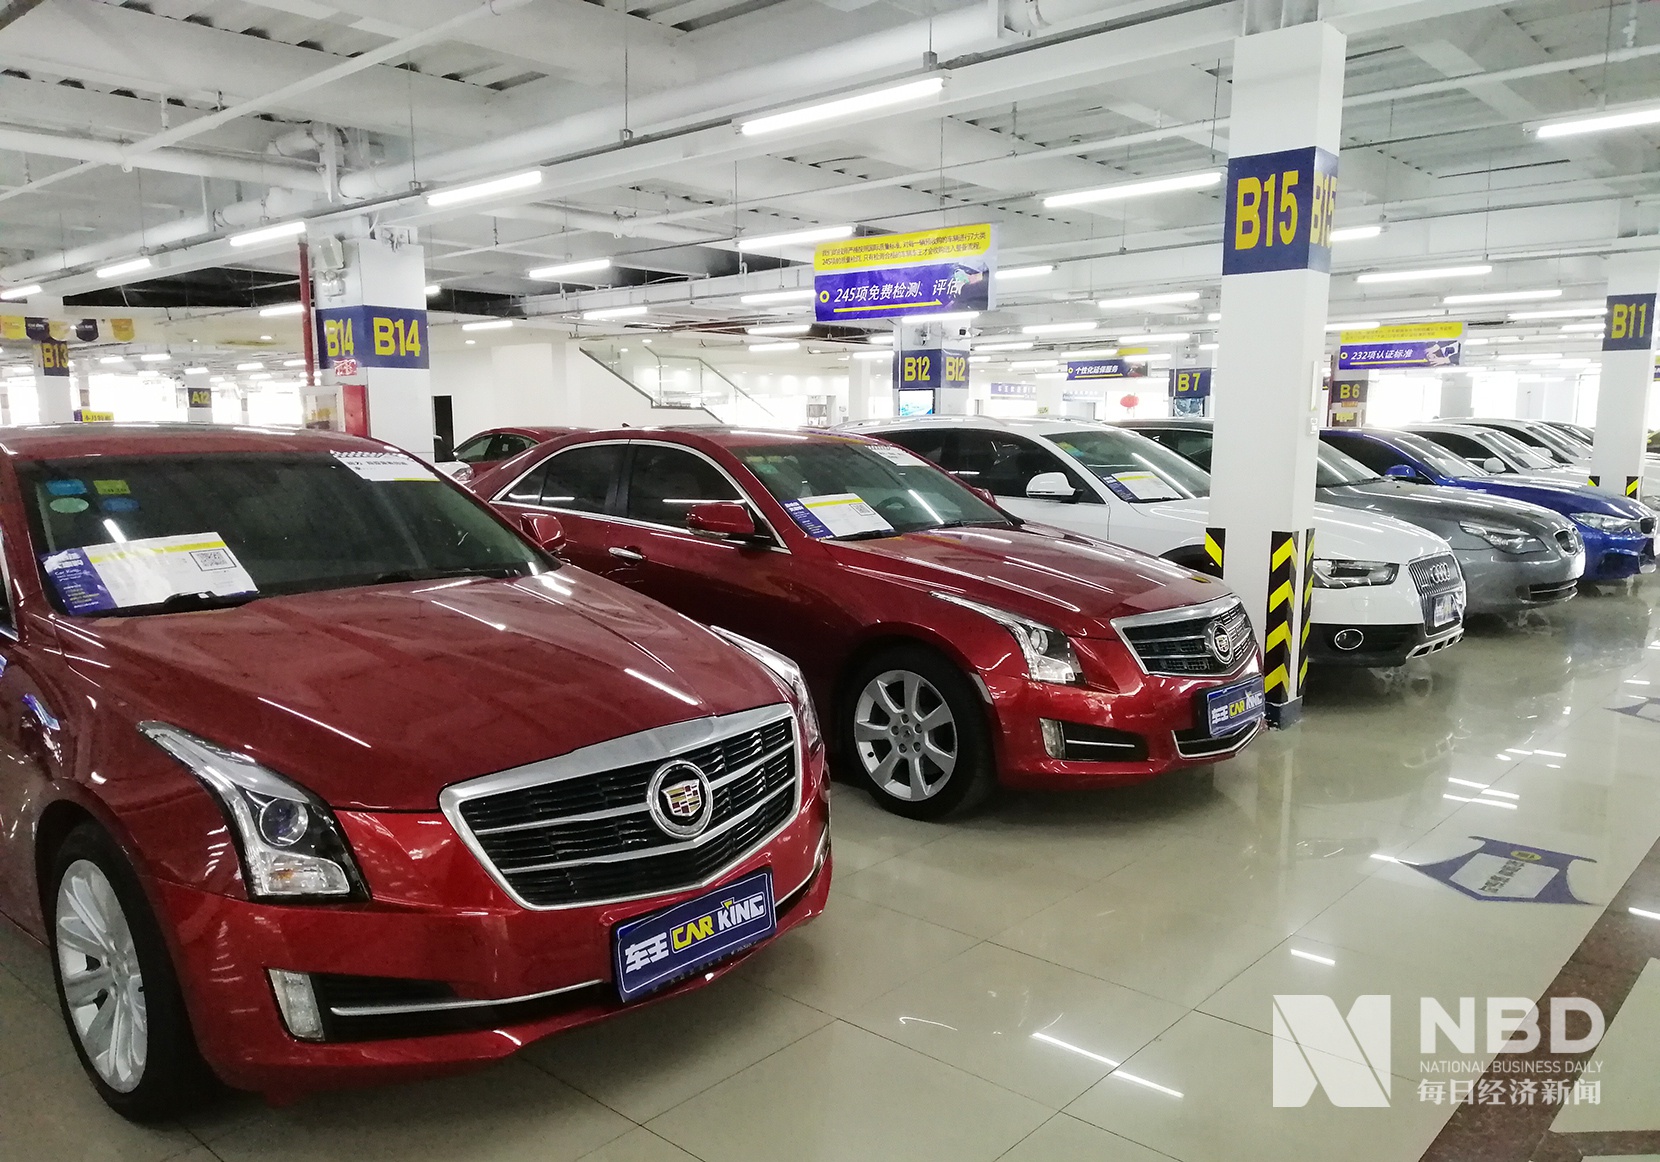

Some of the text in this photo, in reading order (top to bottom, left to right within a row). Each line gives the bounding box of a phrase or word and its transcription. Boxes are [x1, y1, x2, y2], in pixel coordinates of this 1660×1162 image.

[1235, 170, 1299, 250] B15
[1310, 171, 1338, 249] B15
[1611, 303, 1647, 339] B11
[324, 318, 355, 357] B14
[373, 317, 421, 357] B14
[43, 342, 69, 368] B13
[1351, 349, 1414, 361] 232项认证标准
[904, 356, 931, 381] B12
[945, 356, 966, 381] B12
[1178, 373, 1200, 392] B7
[1340, 384, 1360, 399] B6
[1230, 700, 1245, 717] CAR
[625, 931, 670, 974] 车王
[672, 915, 714, 950] CAR
[717, 895, 765, 931] KING
